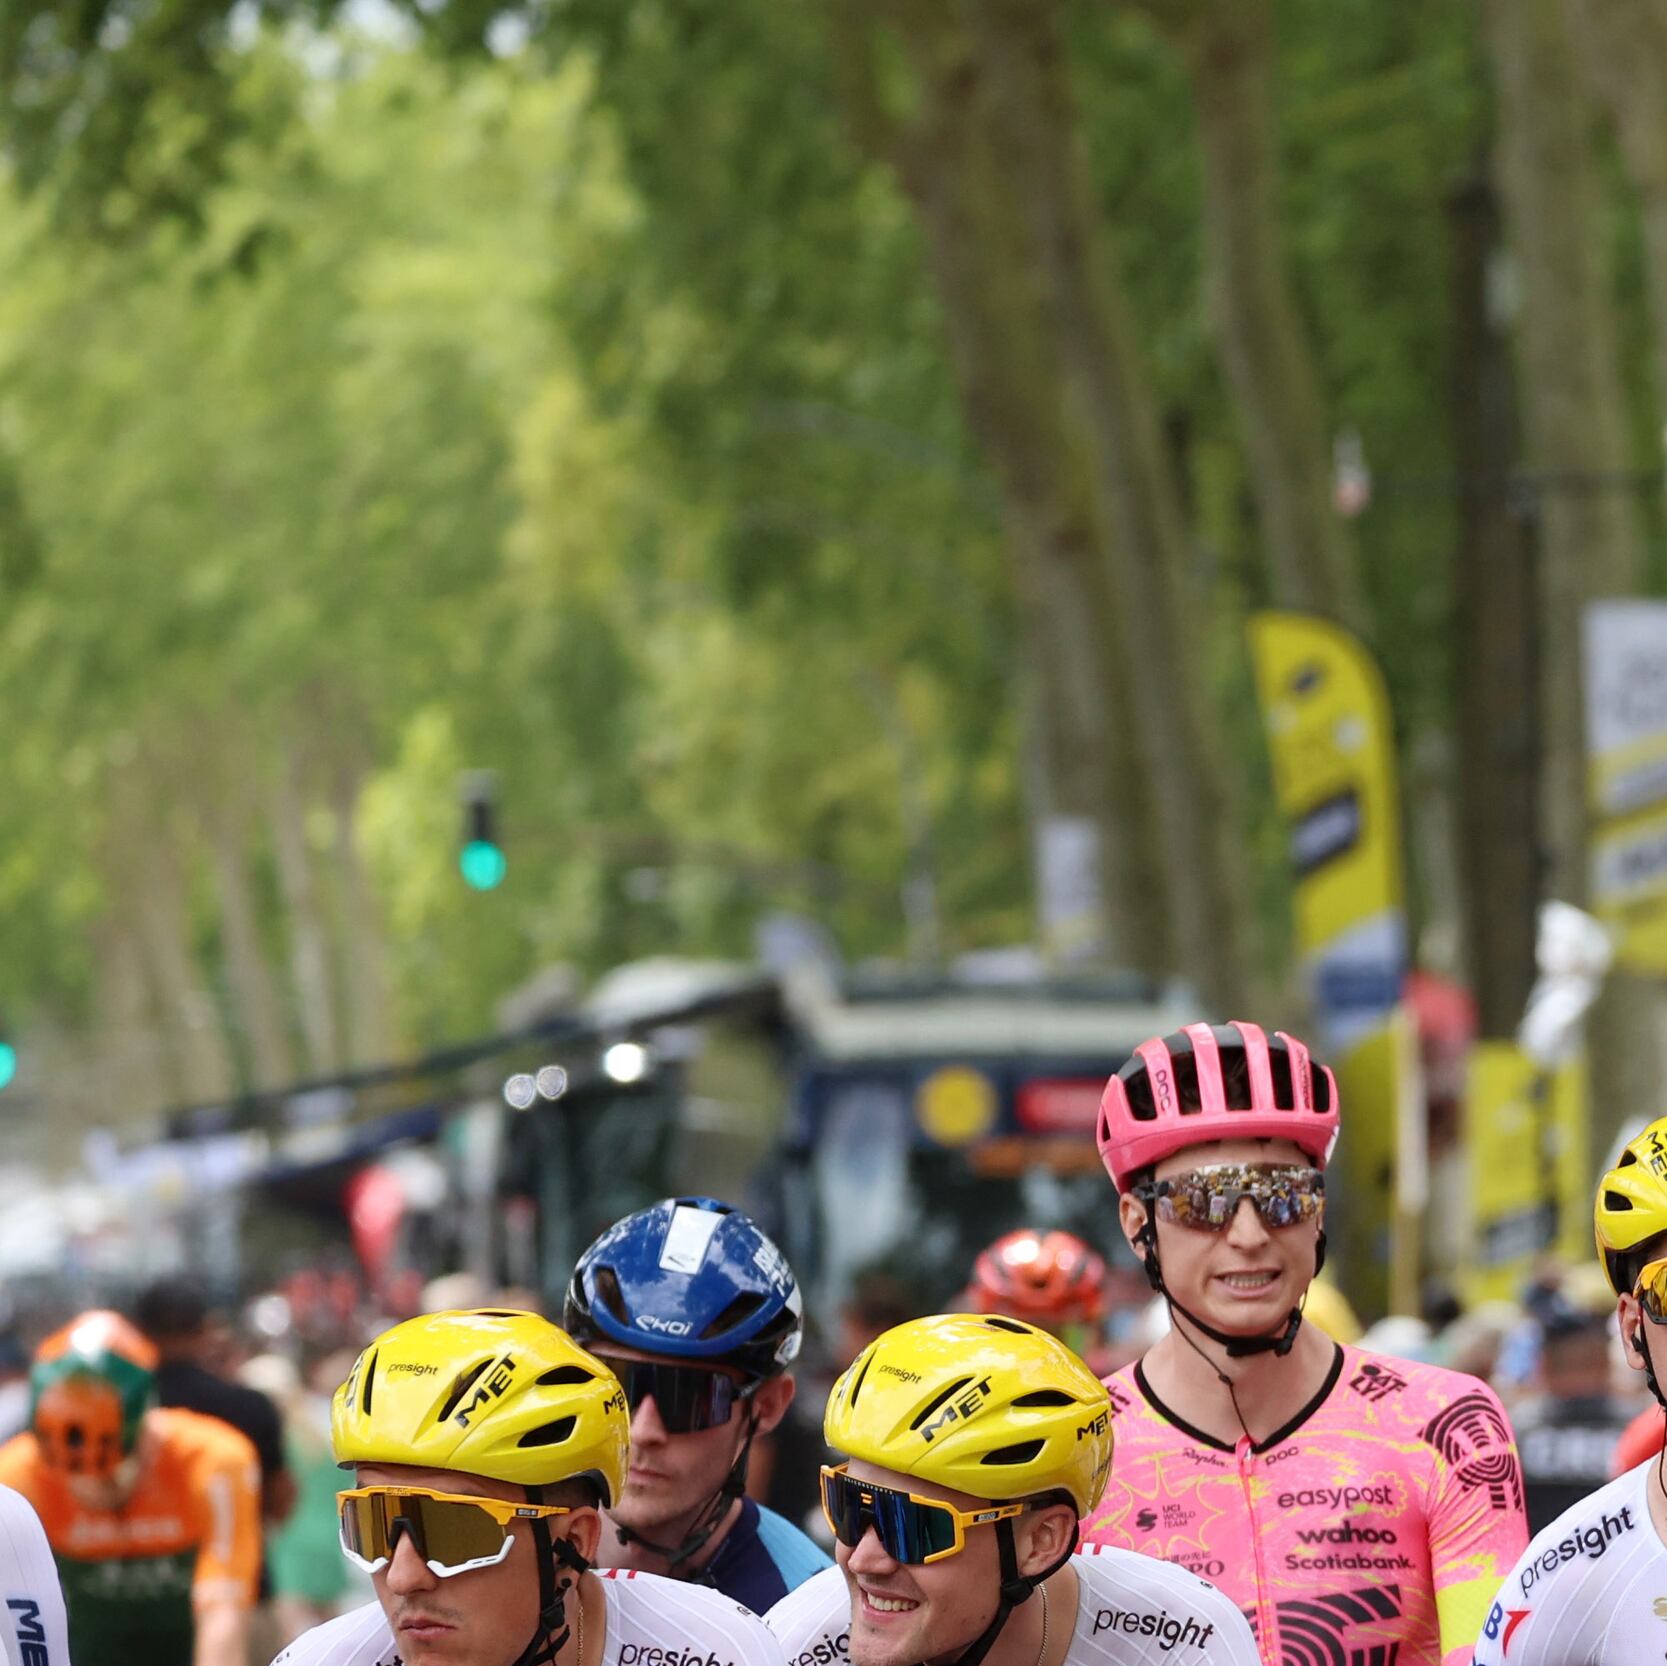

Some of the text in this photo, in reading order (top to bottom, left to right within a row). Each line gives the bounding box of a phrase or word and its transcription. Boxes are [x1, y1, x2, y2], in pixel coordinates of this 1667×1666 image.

[387, 1360, 439, 1378] presight
[878, 1362, 922, 1385] presight
[454, 1352, 518, 1429] MET
[920, 1374, 993, 1444] MET
[1076, 1409, 1109, 1442] MET
[1162, 1504, 1182, 1513] UCI
[1277, 1482, 1393, 1511] easypost
[1162, 1510, 1196, 1521] WORLD
[1163, 1518, 1188, 1529] TEAM
[1296, 1520, 1398, 1546] wahoo
[1518, 1505, 1636, 1599] presight
[1093, 1605, 1214, 1652] presight
